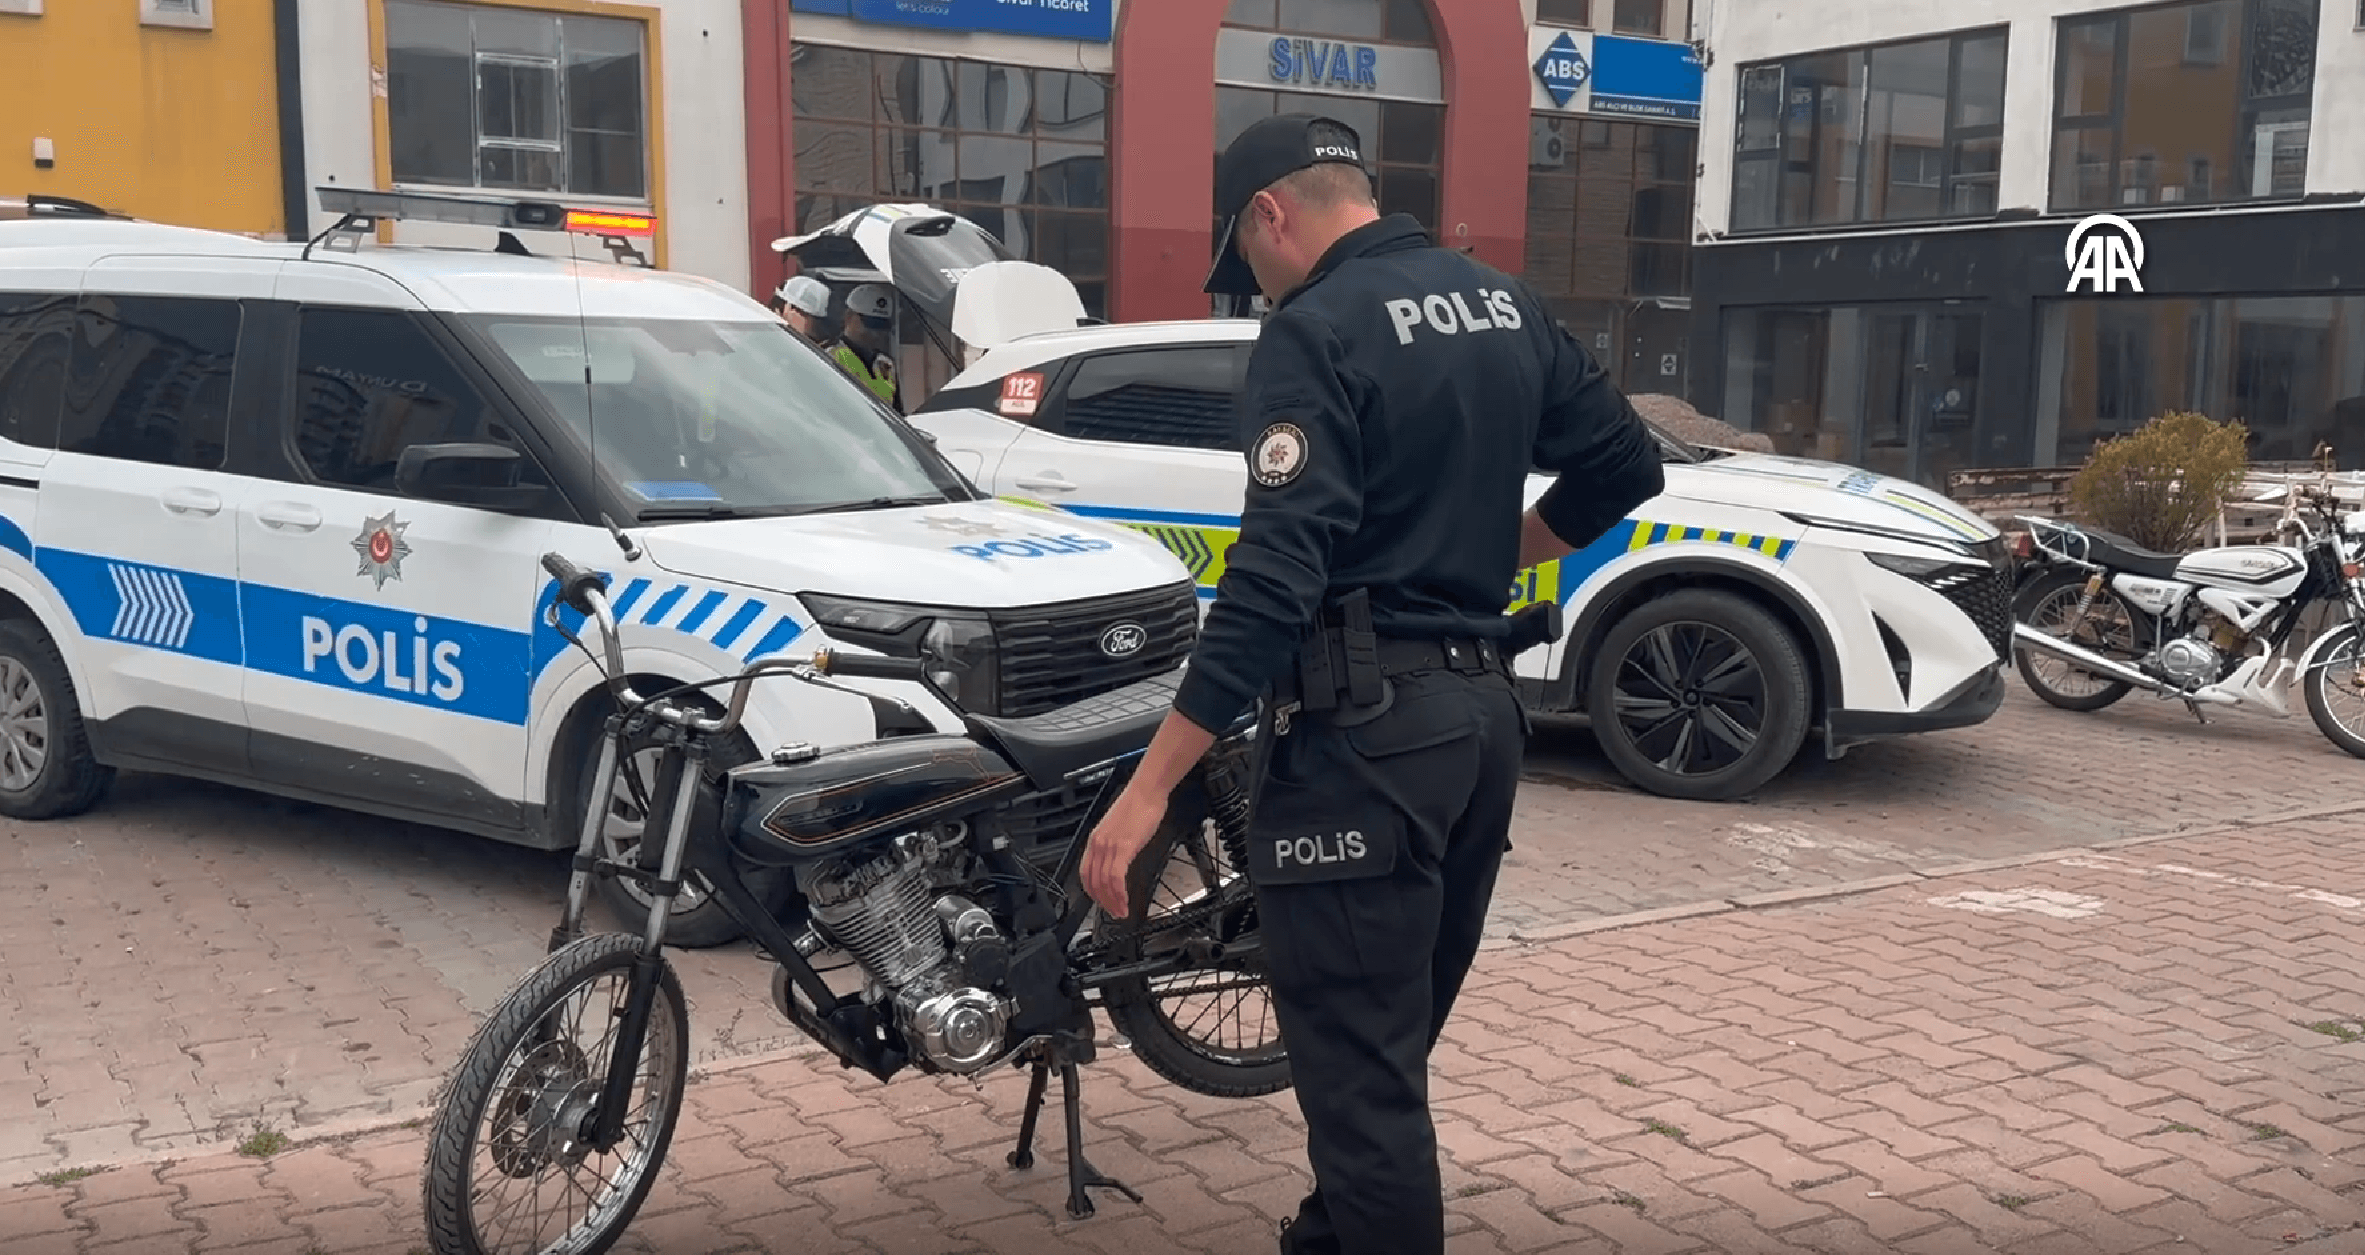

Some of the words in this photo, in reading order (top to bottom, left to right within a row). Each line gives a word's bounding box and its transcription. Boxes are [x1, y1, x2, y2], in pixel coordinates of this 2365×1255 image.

[1543, 58, 1585, 81] ABS
[1008, 376, 1036, 397] 112
[1110, 628, 1140, 652] Ford
